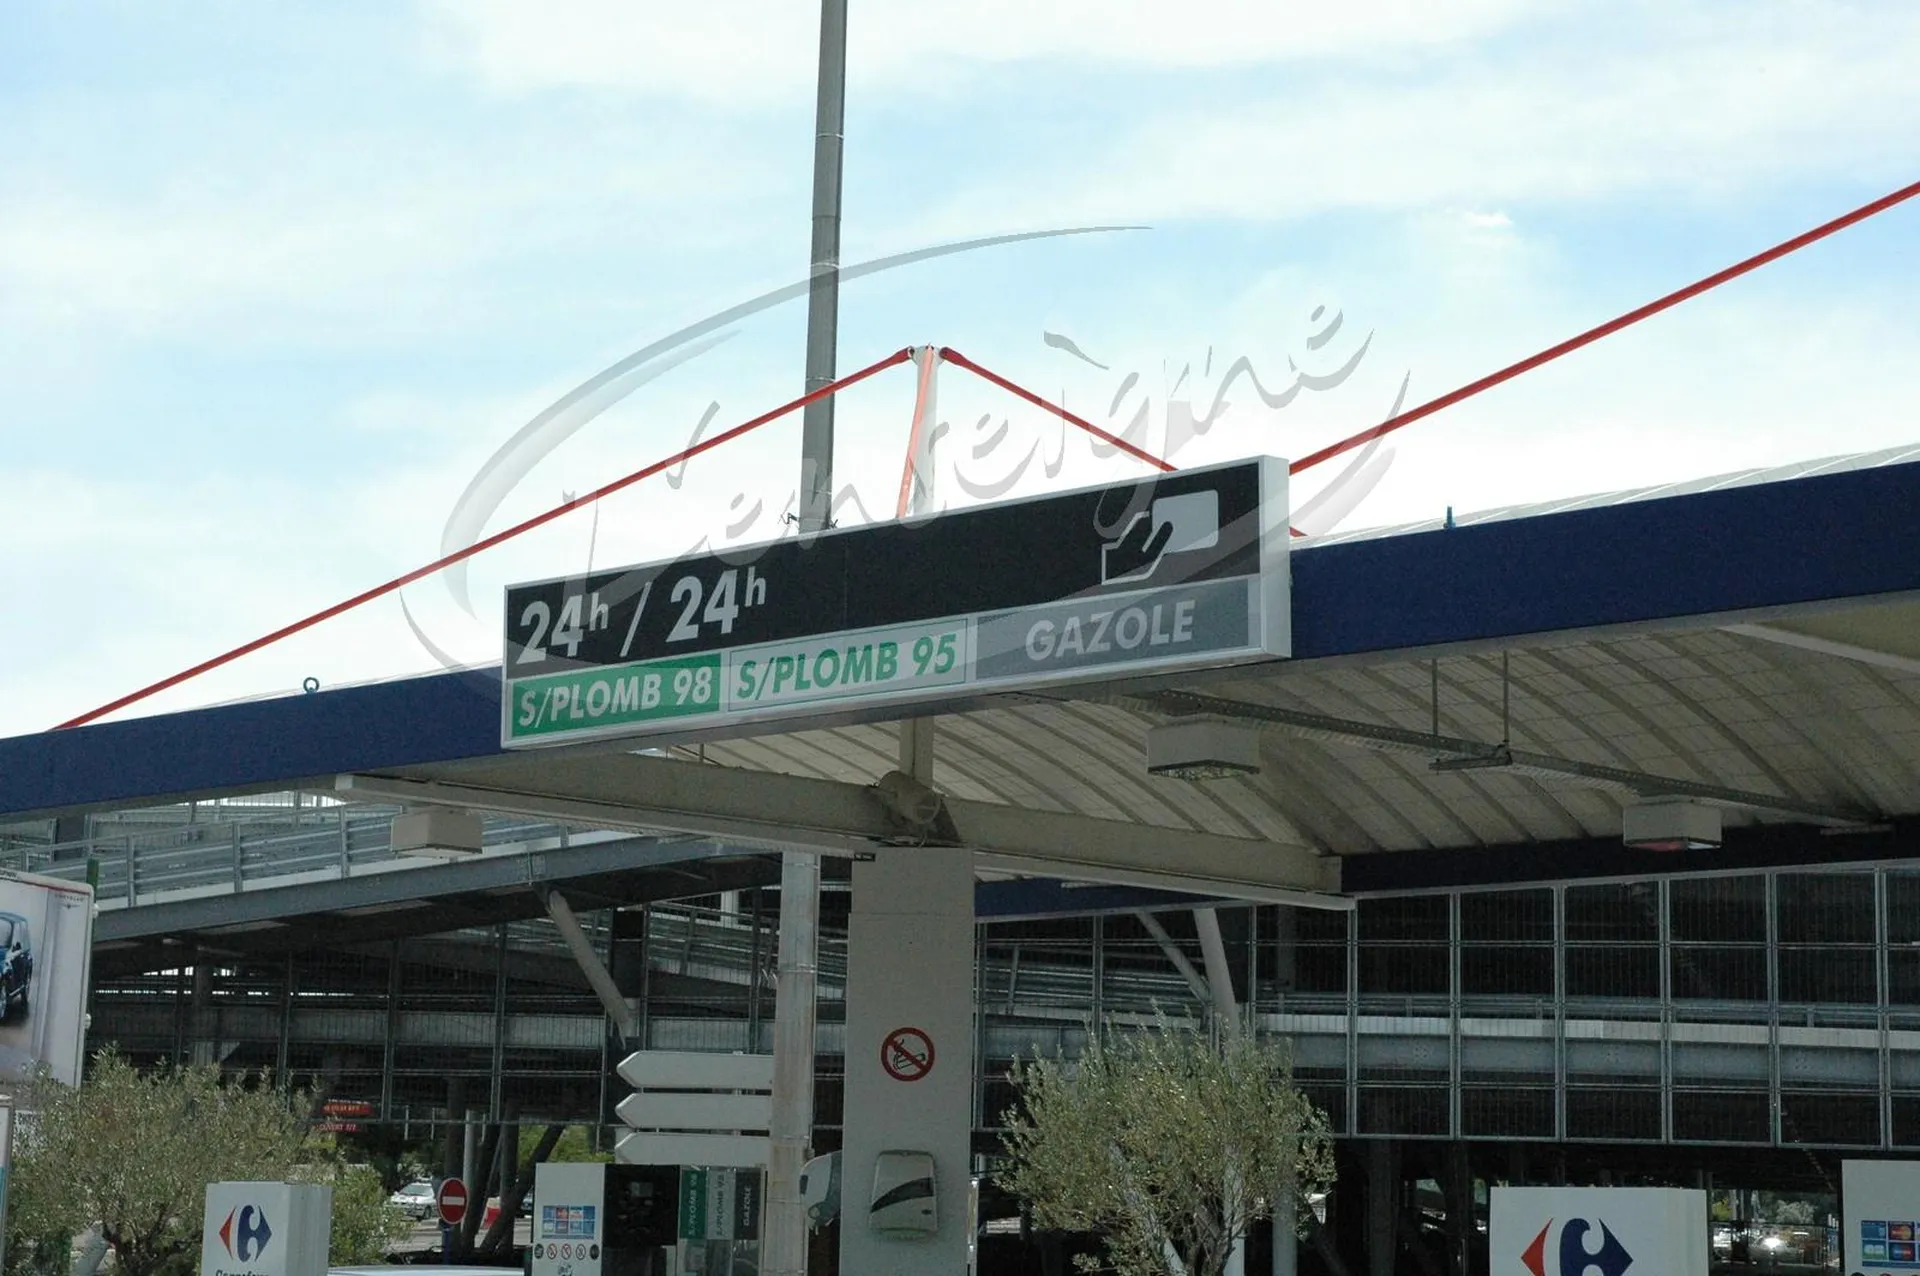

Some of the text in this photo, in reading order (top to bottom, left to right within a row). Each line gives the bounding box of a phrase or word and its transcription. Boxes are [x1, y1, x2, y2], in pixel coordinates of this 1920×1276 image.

[516, 592, 609, 664] 24h
[665, 566, 767, 643] 24h
[1025, 600, 1195, 661] GAZOLE
[519, 666, 712, 729] S/PLOMB 98
[737, 633, 957, 700] S/PLOMB 95
